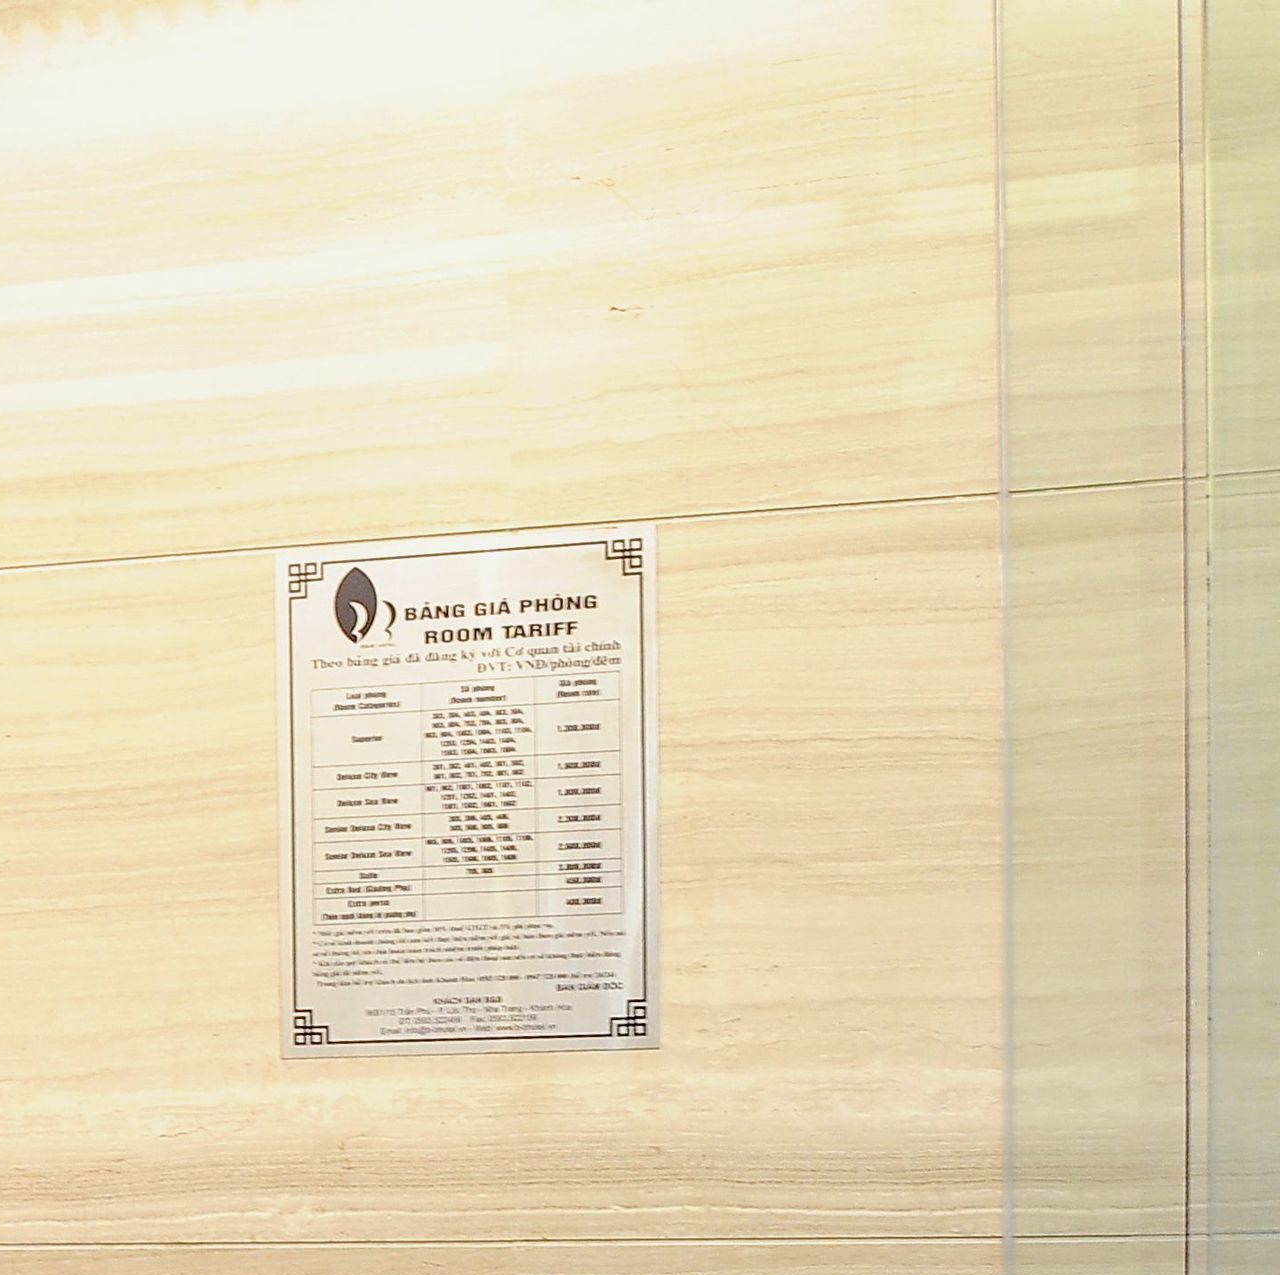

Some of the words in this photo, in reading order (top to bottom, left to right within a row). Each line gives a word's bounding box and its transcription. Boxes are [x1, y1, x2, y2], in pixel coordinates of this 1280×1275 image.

[404, 600, 466, 621] BẢNG
[474, 597, 512, 617] GIÁ
[520, 594, 598, 614] PHÒNG
[424, 627, 493, 645] ROOM
[503, 621, 579, 640] TARIFF
